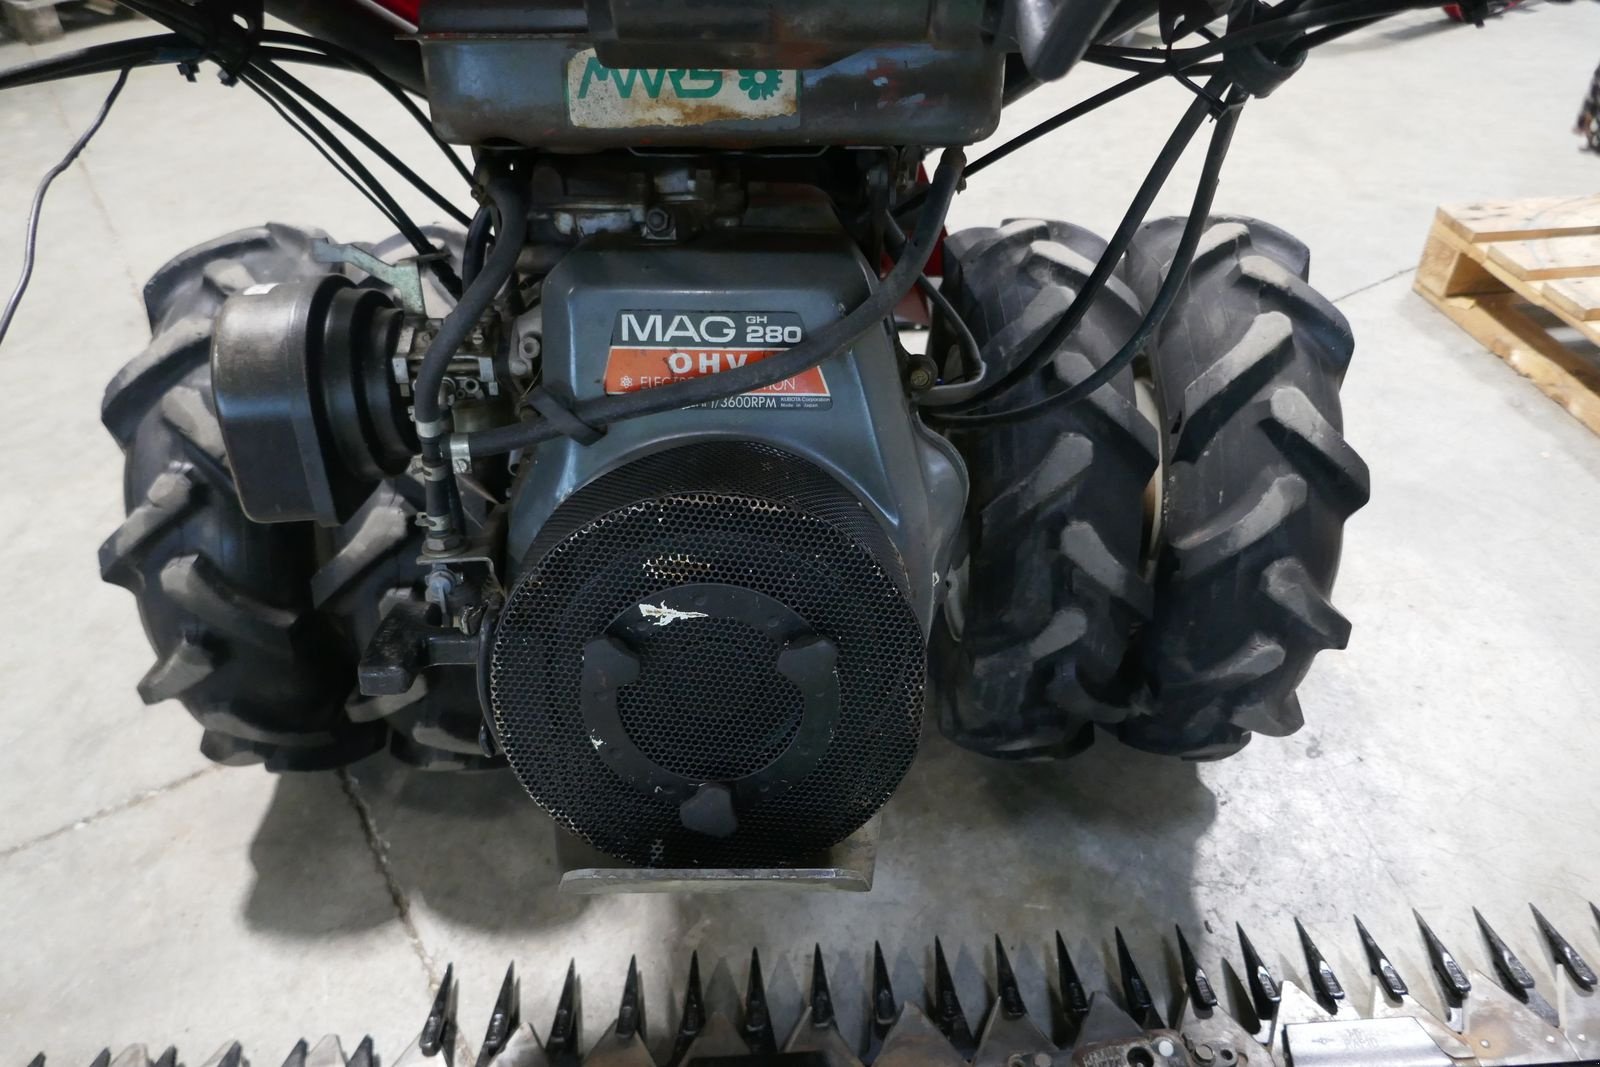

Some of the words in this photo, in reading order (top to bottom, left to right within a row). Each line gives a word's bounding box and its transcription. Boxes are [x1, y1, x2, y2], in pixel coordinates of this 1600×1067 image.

[621, 313, 737, 344] MAG
[745, 315, 768, 324] GH
[746, 326, 802, 344] 280
[668, 352, 748, 374] OHV
